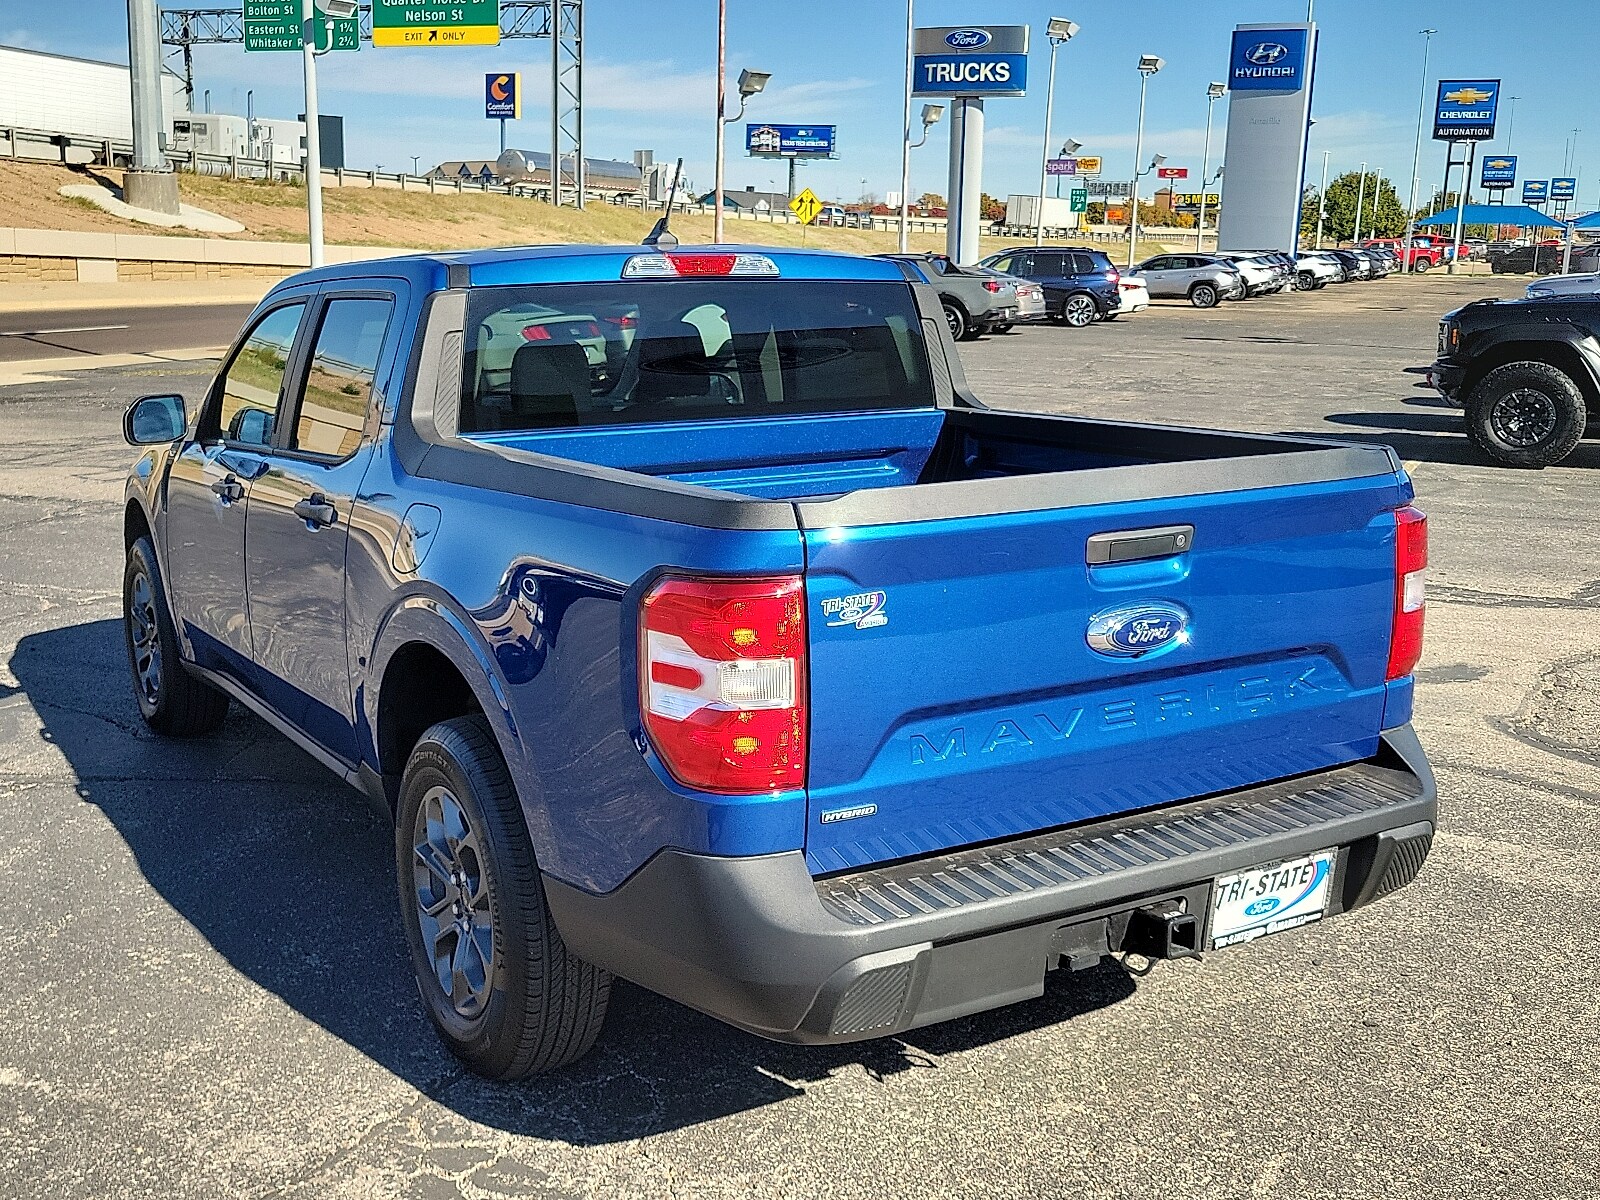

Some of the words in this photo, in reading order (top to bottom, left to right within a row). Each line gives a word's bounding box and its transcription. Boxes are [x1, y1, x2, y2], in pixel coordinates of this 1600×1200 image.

[248, 5, 280, 16] Bolton
[284, 4, 294, 15] St
[405, 9, 446, 21] Nelson
[451, 9, 464, 20] St
[248, 25, 288, 35] Eastern
[289, 24, 299, 34] St
[404, 33, 423, 41] EXIT
[442, 32, 466, 41] ONLY
[952, 31, 980, 45] Ford
[249, 38, 293, 48] Whitaker
[297, 38, 304, 47] R
[924, 62, 1010, 83] TRUCKS
[1235, 66, 1295, 78] HYUNDAI
[487, 102, 514, 111] Comfort
[1439, 111, 1492, 119] CHEVROLET
[1437, 128, 1490, 136] AUTONATION
[1047, 161, 1074, 173] spark
[1072, 195, 1086, 203] 72A
[1191, 194, 1219, 204] MLES
[823, 593, 876, 614] TRI-STATE
[1128, 618, 1171, 644] Ford
[910, 666, 1320, 765] MAVERICK
[824, 806, 875, 822] HYBRID
[1215, 862, 1314, 910] TRI-STATE
[1250, 898, 1277, 915] Ford
